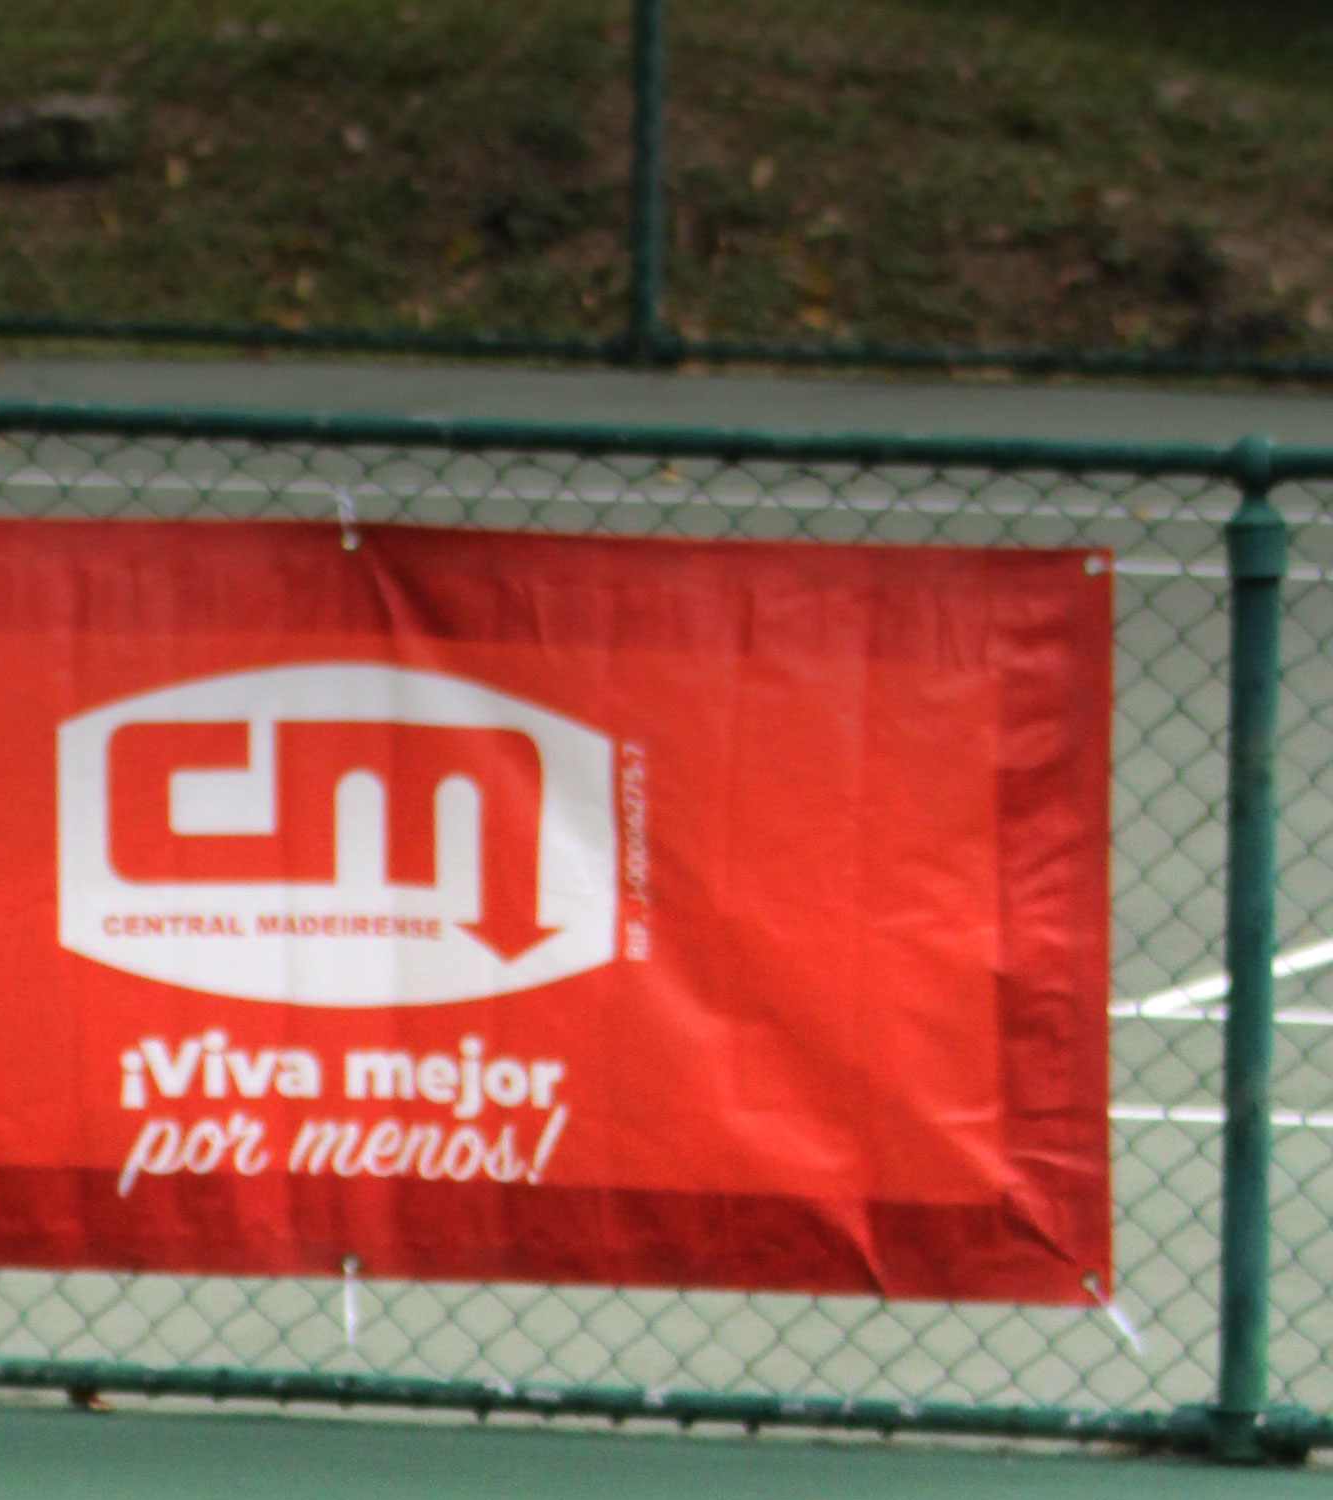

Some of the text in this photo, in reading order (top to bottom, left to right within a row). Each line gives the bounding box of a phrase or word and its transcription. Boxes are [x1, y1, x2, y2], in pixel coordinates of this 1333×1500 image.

[102, 913, 441, 941] CENTRAL MADEIRENSE
[120, 1030, 564, 1119] ¡Viva mejor
[117, 1103, 568, 1197] por menos!
